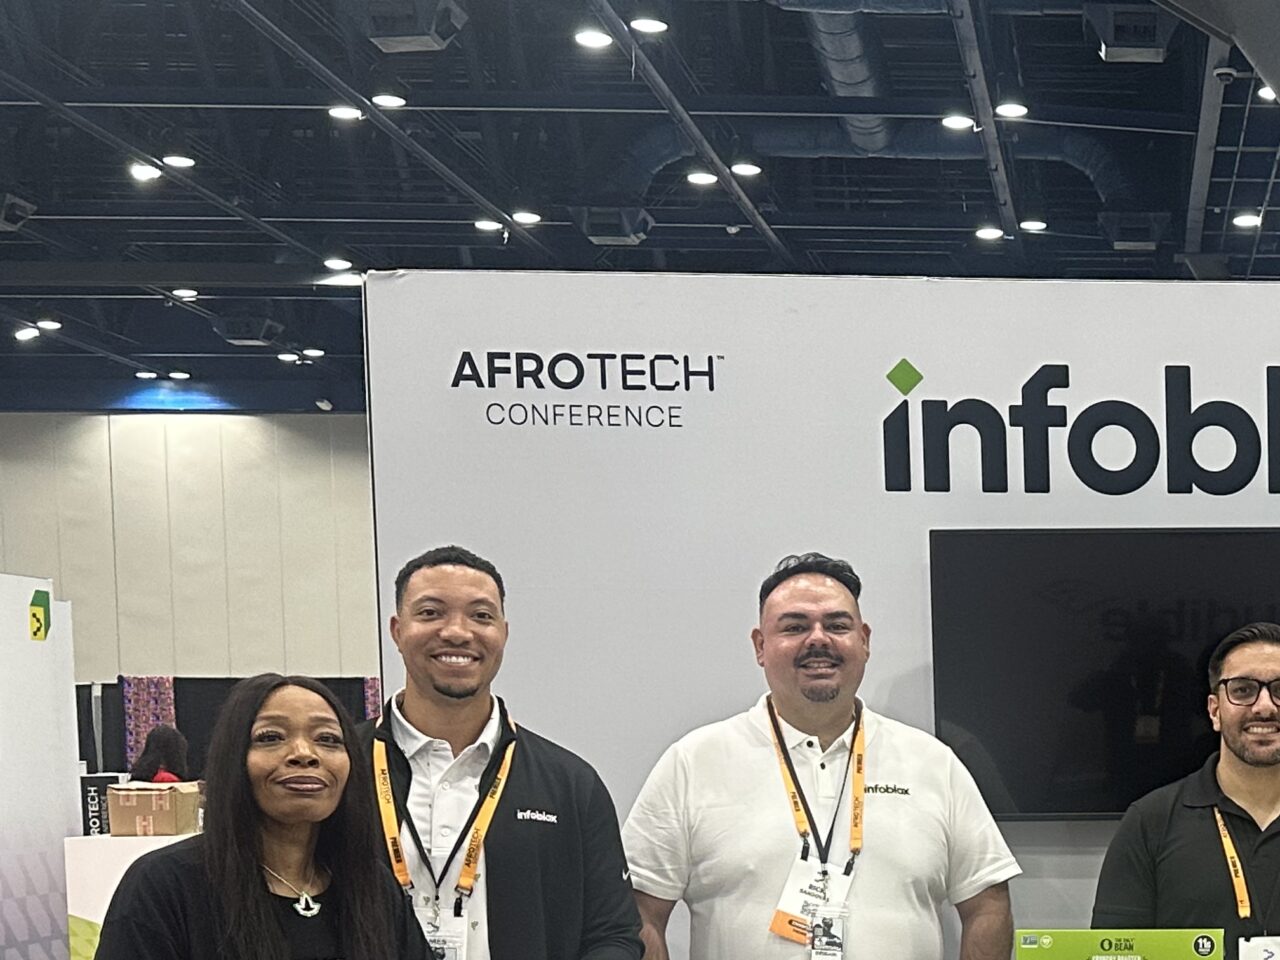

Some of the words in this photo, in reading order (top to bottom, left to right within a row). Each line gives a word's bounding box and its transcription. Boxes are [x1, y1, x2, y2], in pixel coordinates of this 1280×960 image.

[486, 402, 683, 427] CONFERENCE
[863, 784, 910, 796] infoblox
[517, 808, 558, 824] infoblox
[464, 828, 480, 868] AFROTECH
